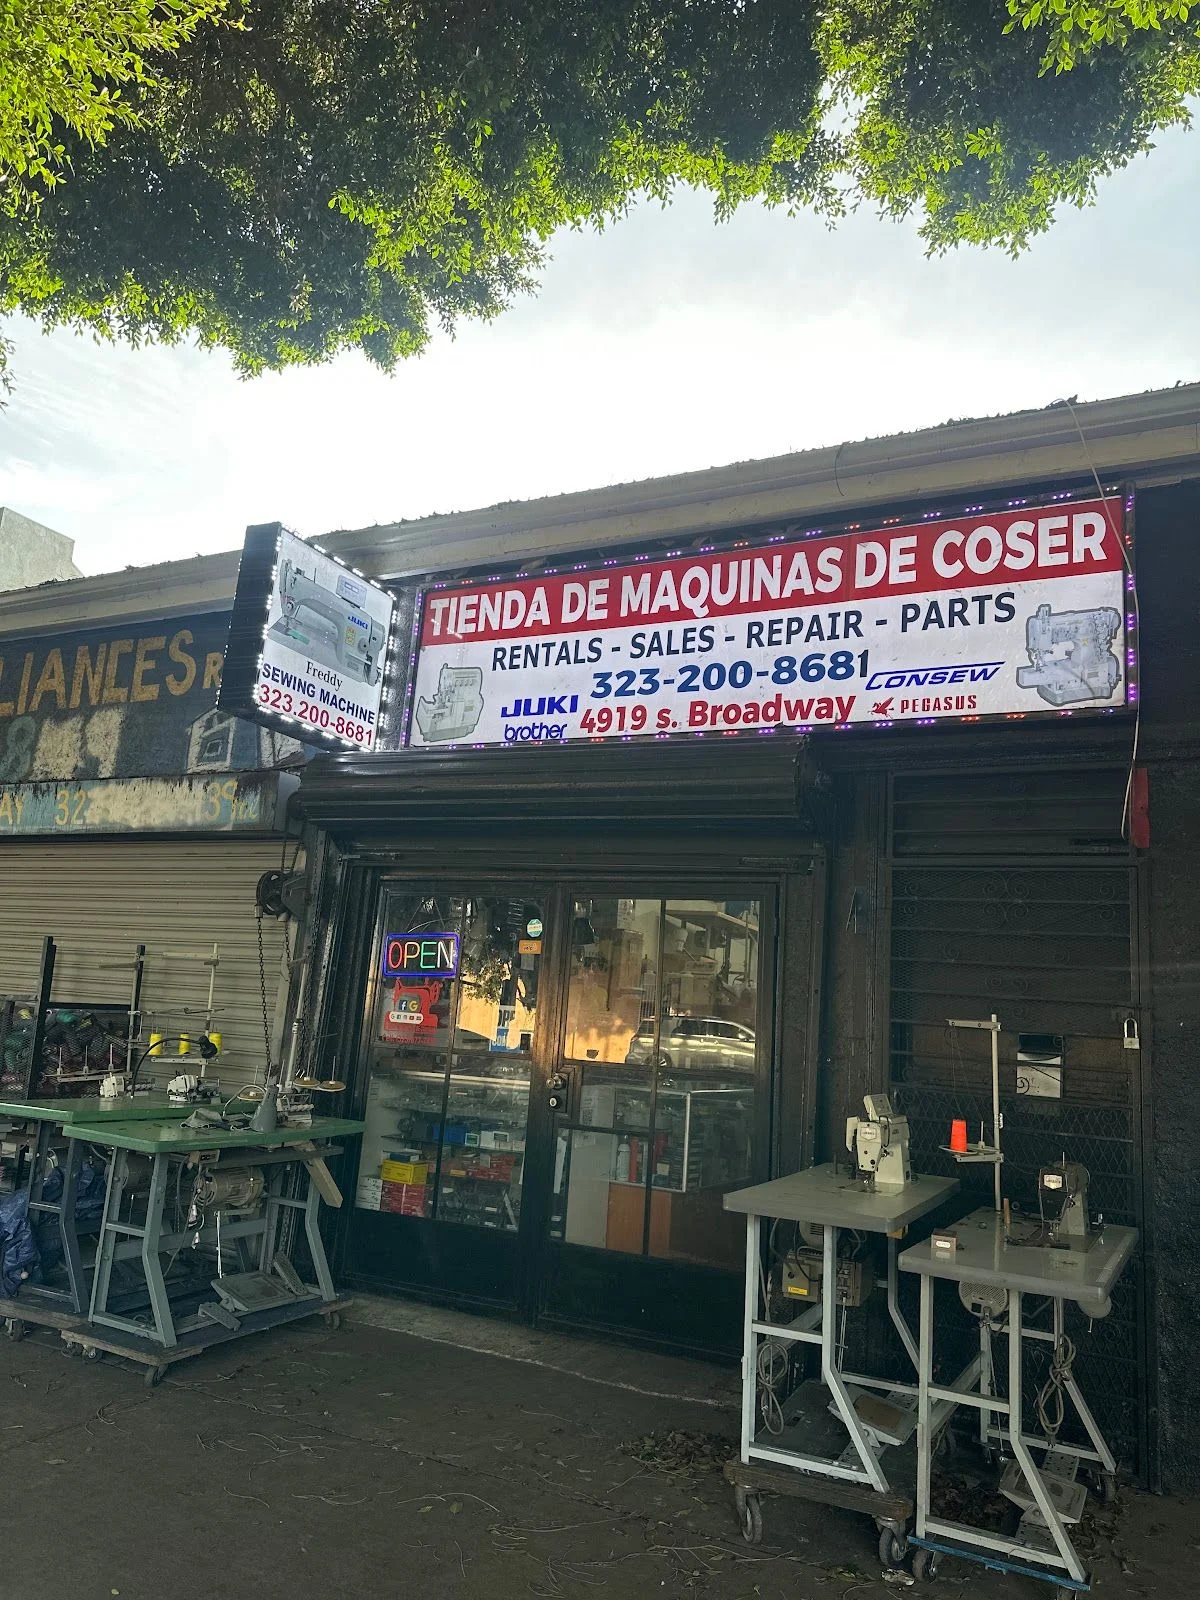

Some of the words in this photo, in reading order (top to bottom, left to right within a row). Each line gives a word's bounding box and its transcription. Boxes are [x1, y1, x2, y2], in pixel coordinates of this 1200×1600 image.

[431, 588, 550, 636] TIENDA
[561, 578, 608, 624] DE
[620, 547, 843, 618] MAQUINAS
[855, 536, 917, 589] DE
[932, 511, 1107, 579] COSER
[492, 637, 602, 671] RENTALS
[630, 625, 715, 659] SALES
[746, 610, 864, 648] REPAIR
[901, 592, 1016, 633] PARTS
[305, 660, 343, 692] Freddy
[590, 649, 869, 699] 323-200-8681
[865, 661, 1006, 691] CONSEW
[262, 662, 315, 698] SEWING
[319, 689, 376, 725] MACHINE
[500, 694, 579, 718] JUKI
[900, 694, 977, 714] PEGASUS
[259, 683, 373, 746] 323.200-8681
[504, 722, 567, 741] brother
[580, 704, 647, 734] 4919
[656, 708, 678, 729] s.
[688, 693, 856, 727] Broadway
[388, 941, 454, 969] OPEN
